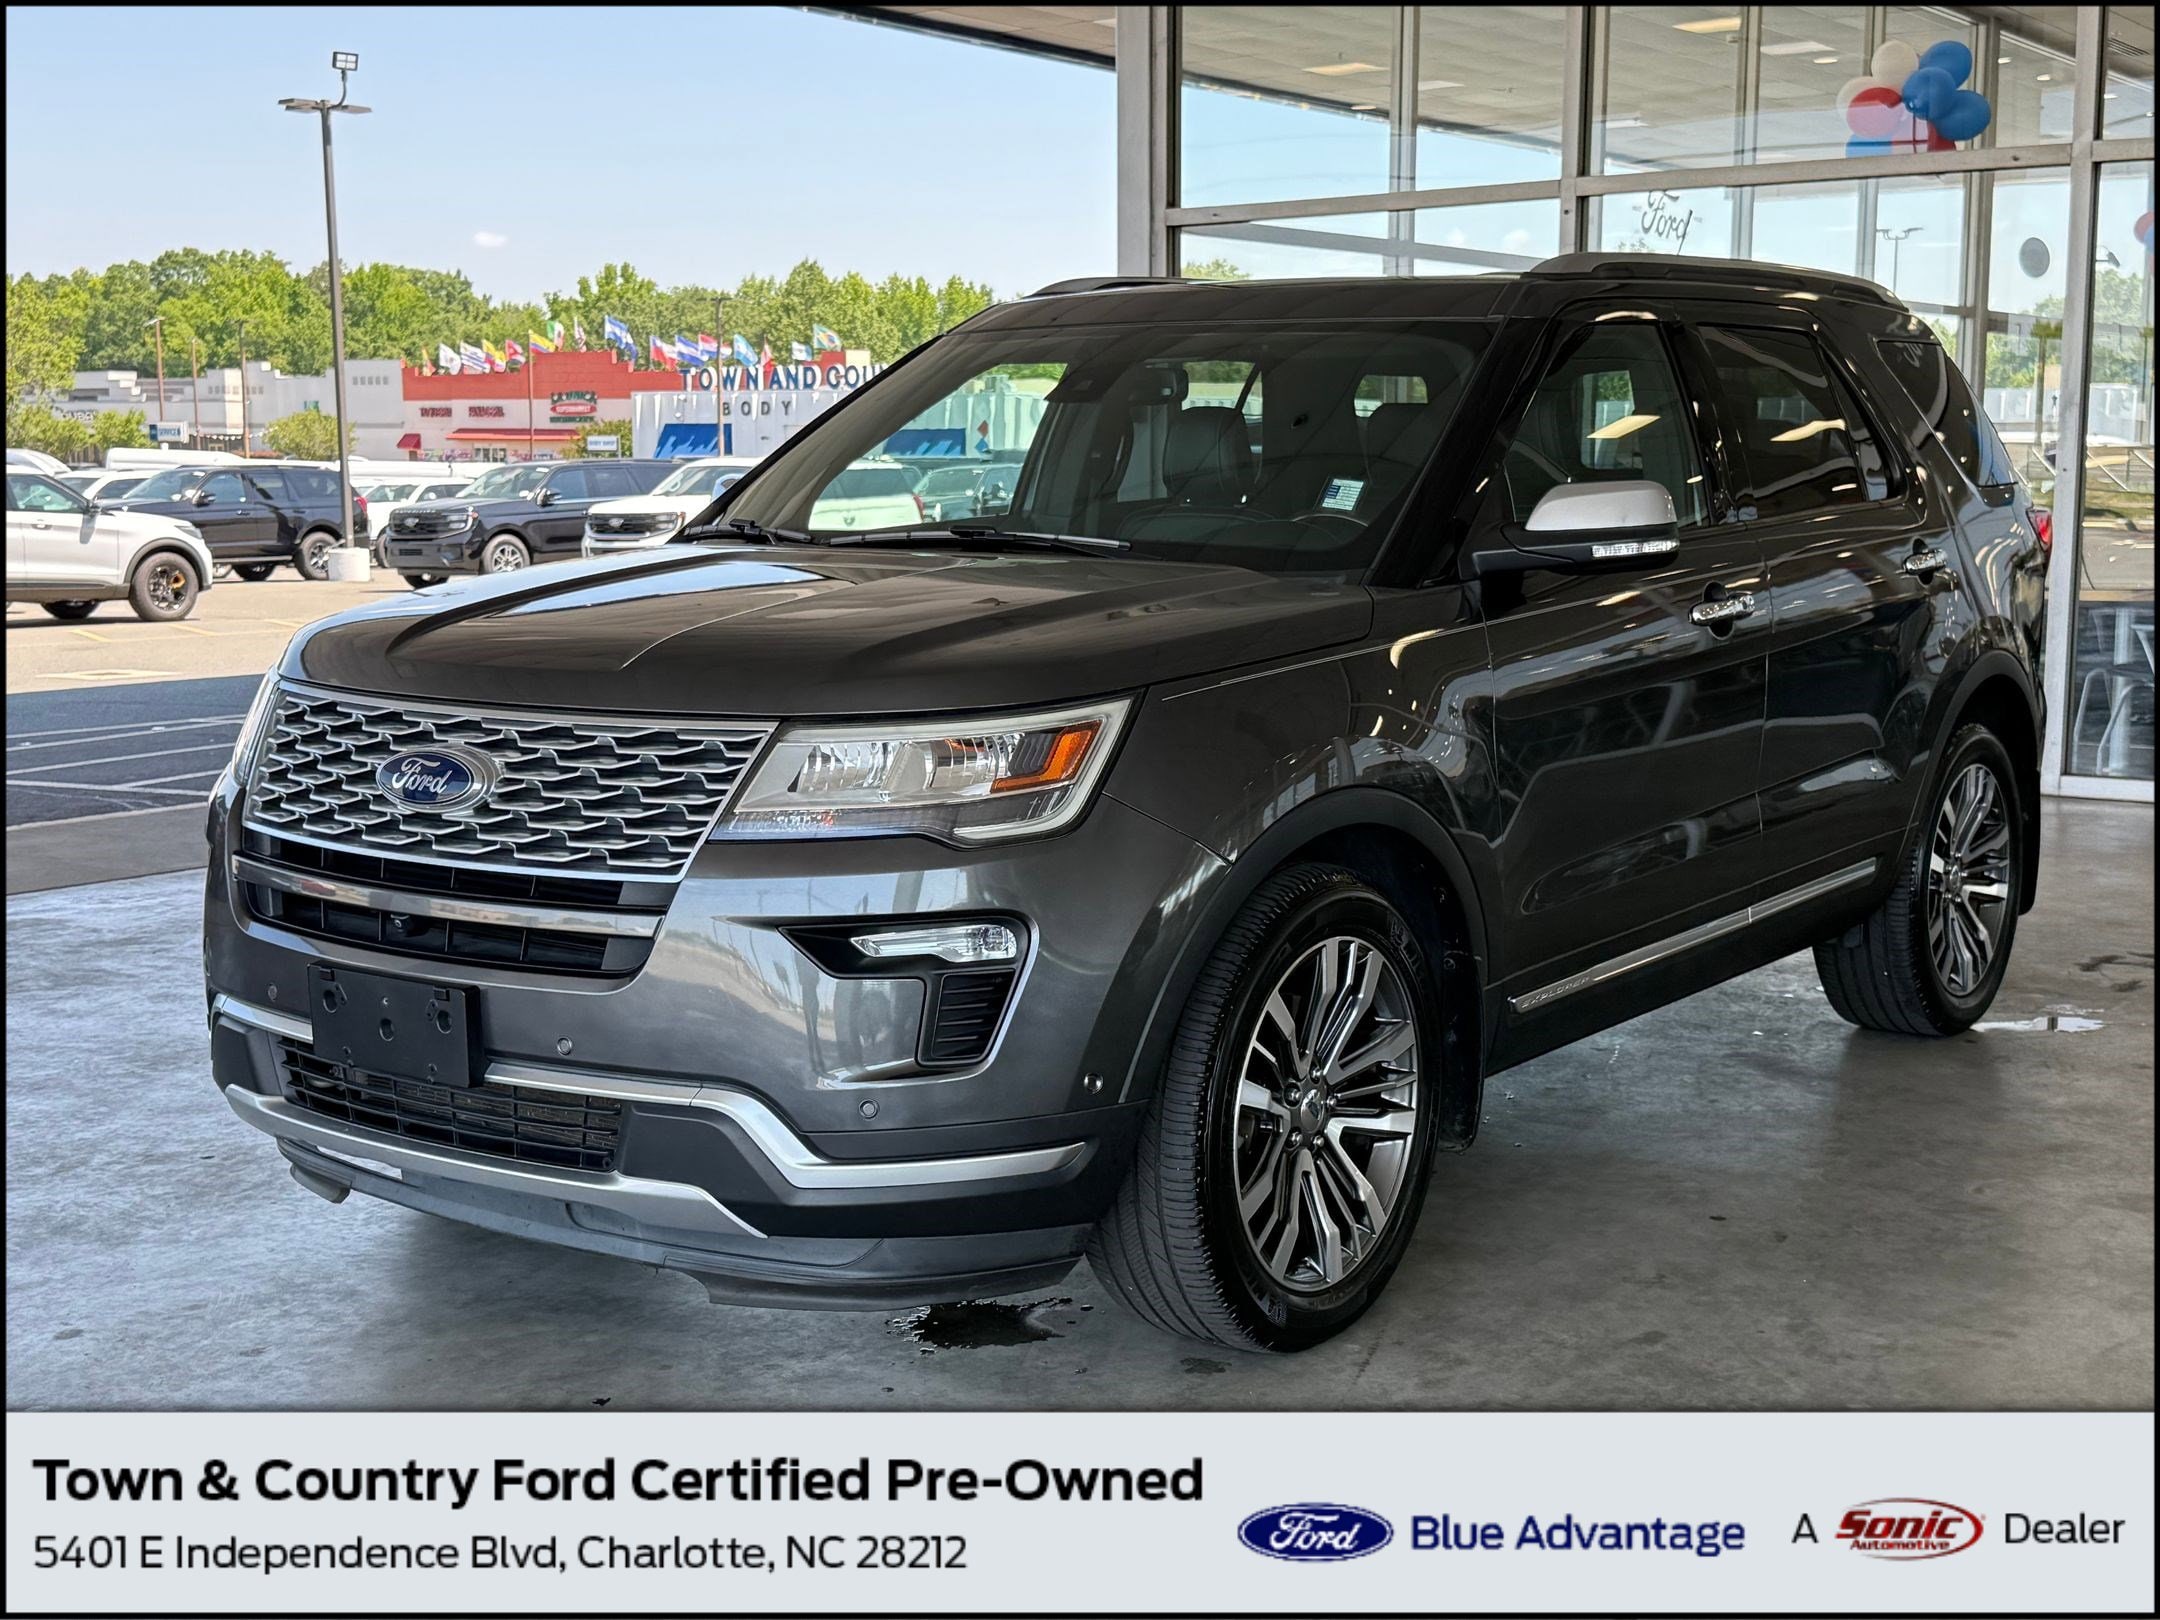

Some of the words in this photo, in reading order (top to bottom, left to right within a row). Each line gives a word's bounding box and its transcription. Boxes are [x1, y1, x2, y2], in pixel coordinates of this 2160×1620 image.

[1641, 190, 1693, 254] Ford
[680, 367, 760, 391] TOWN
[770, 367, 817, 390] AND
[722, 401, 792, 416] BODY
[391, 757, 453, 794] Ford
